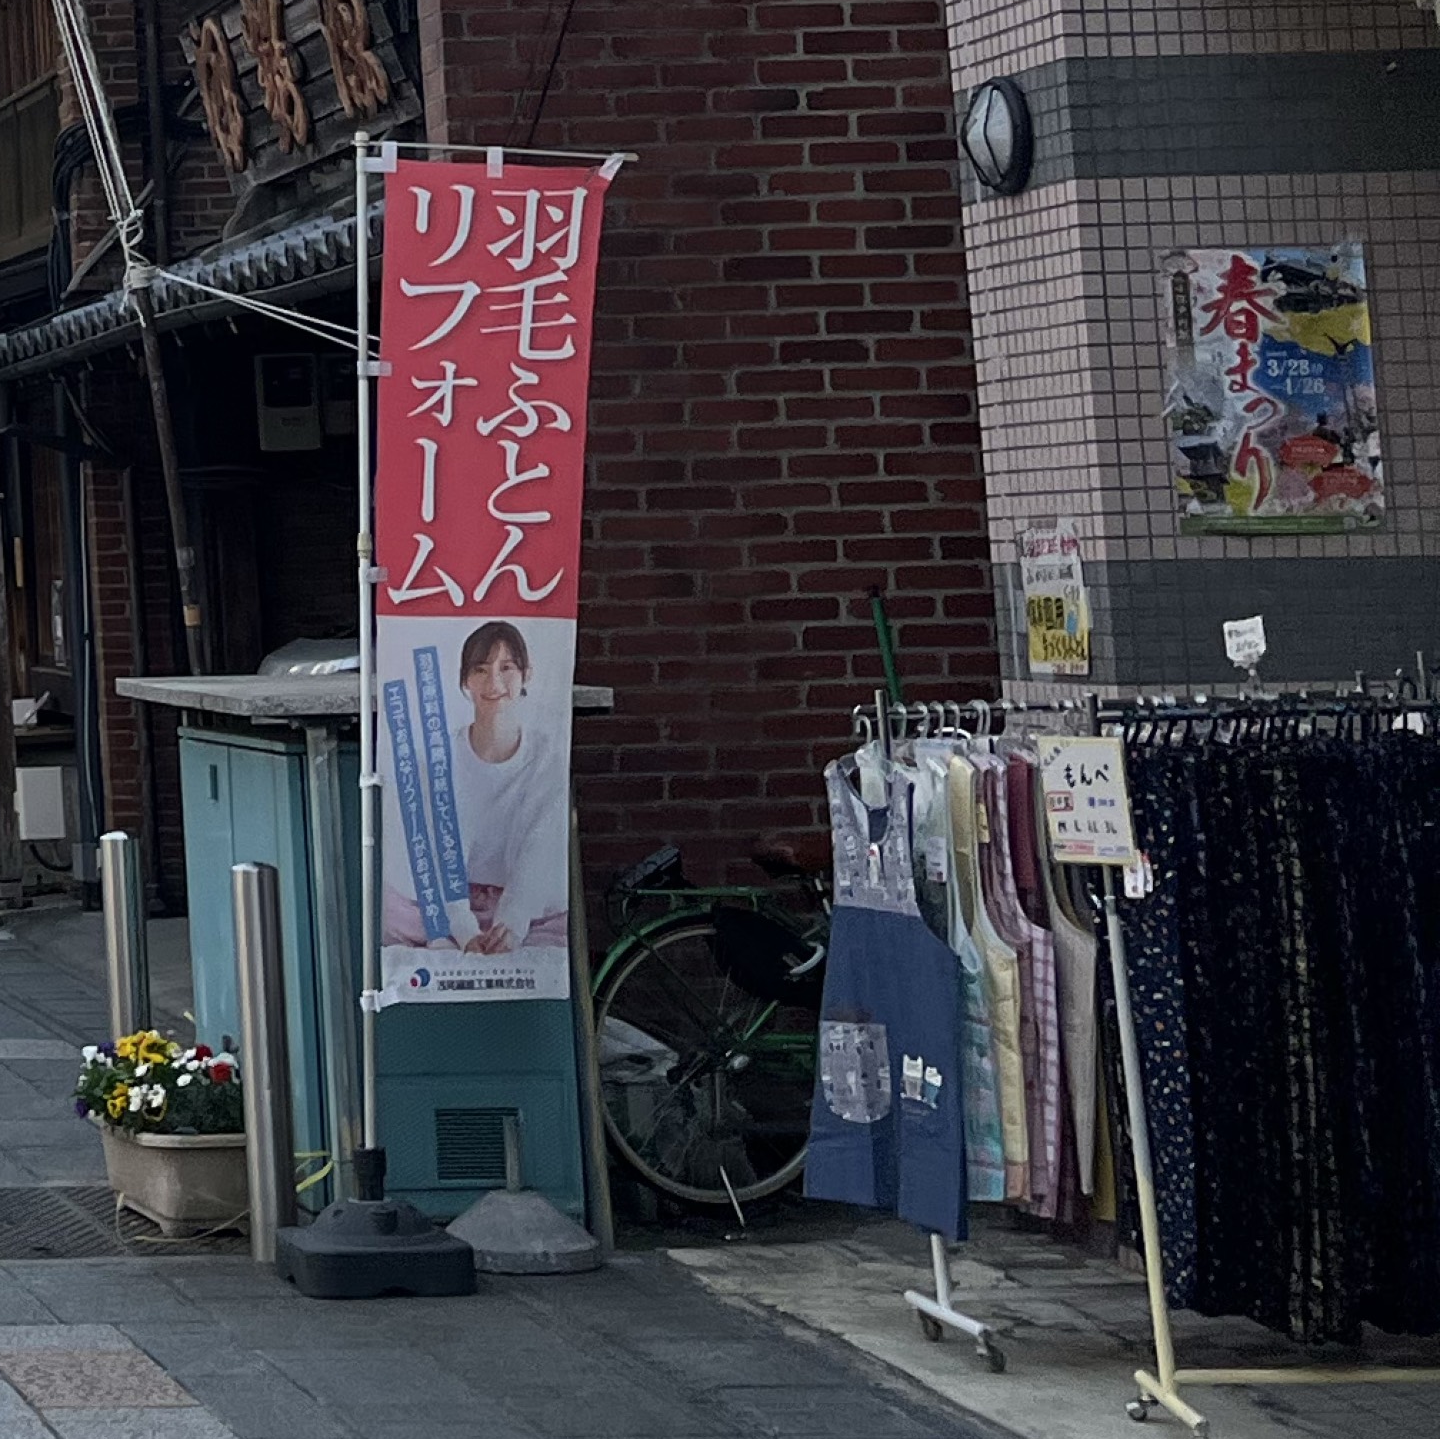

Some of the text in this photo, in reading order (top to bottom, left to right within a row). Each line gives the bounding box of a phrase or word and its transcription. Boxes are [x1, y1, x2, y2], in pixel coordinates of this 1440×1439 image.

[386, 184, 484, 608] リフォーム
[474, 185, 588, 604] 羽毛ふとん
[1200, 254, 1286, 511] 春まつり
